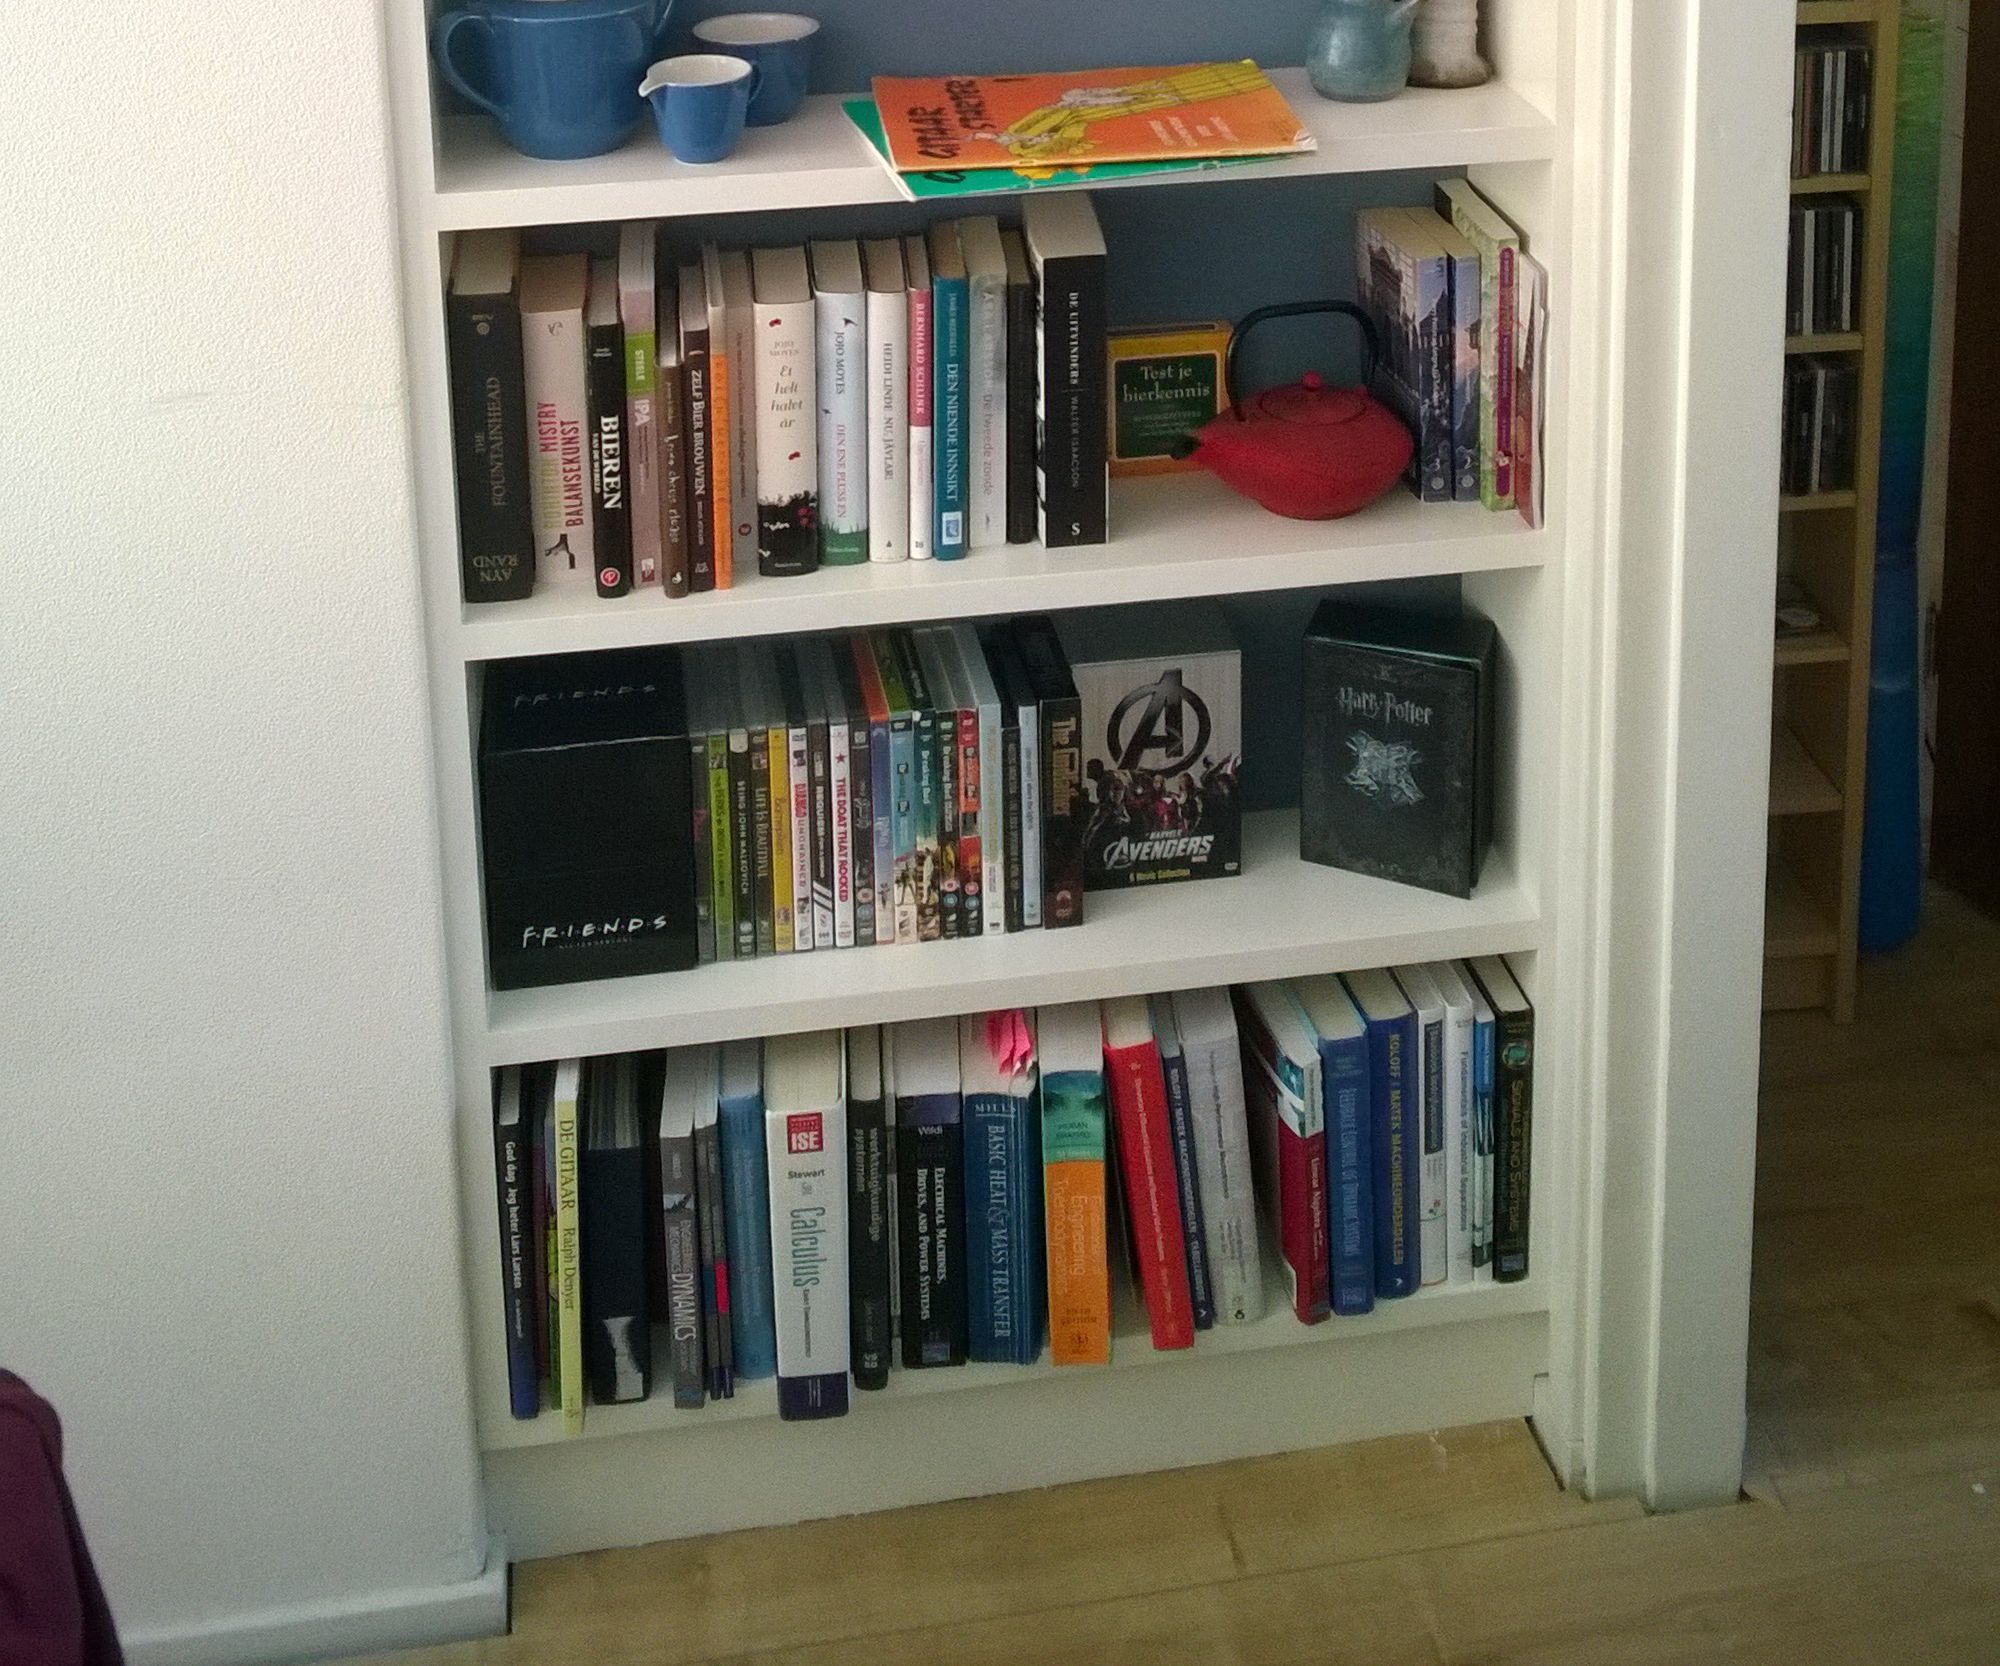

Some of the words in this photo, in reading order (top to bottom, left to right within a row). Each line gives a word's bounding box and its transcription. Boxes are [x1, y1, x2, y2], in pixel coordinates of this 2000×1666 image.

[1069, 292, 1079, 309] DE
[834, 331, 845, 356] JOJO
[915, 303, 925, 363] BERNHARD
[1069, 311, 1080, 385] UITVINDERS
[780, 365, 793, 377] Et
[836, 358, 845, 395] MOYES
[883, 343, 893, 375] HEIDI
[1140, 364, 1175, 381] Test
[1179, 362, 1193, 380] je
[691, 370, 703, 399] ZELF
[775, 381, 798, 394] helt
[883, 377, 893, 412] LINDE
[915, 366, 925, 414] SCHLINK
[945, 363, 958, 392] DEN
[1122, 380, 1210, 403] bierkennis
[634, 399, 650, 427] IPA
[771, 399, 803, 412] halvt
[983, 394, 993, 411] De
[1070, 396, 1079, 434] WALTER
[537, 402, 558, 452] MISTRY
[836, 424, 845, 447] DEN
[945, 395, 959, 447] NIENDE
[983, 413, 994, 458] tweede
[486, 376, 508, 507] FOUNTAINHEAD
[836, 448, 845, 469] ENE
[560, 419, 584, 527] BALANSEKUNST
[600, 415, 622, 510] BIEREN
[693, 432, 706, 495] BROUWEN
[946, 448, 959, 502] INNSIKT
[983, 458, 994, 496] zonde
[1070, 437, 1080, 489] ISAACSON
[837, 503, 846, 518] EN
[472, 554, 519, 568] RAND
[479, 567, 512, 584] AYN
[1337, 687, 1380, 719] Harry
[1384, 691, 1433, 726] Potter
[942, 746, 952, 782] Breaking
[737, 780, 746, 810] BEING
[754, 787, 767, 809] LIFE
[836, 777, 847, 798] THE
[944, 783, 953, 800] Bad
[738, 812, 747, 838] JOHN
[815, 785, 825, 836] REQUIEM
[837, 799, 847, 829] BOAT
[756, 823, 769, 878] BEAUTIFUL
[838, 830, 848, 859] THAT
[1103, 834, 1214, 870] AVENGERS
[739, 840, 749, 895] MALKOVICH
[838, 859, 848, 903] ROCKED
[1459, 1050, 1469, 1117] Fundamentals
[1460, 1119, 1469, 1129] of
[1508, 1079, 1522, 1138] SIGNALS
[559, 1119, 575, 1144] DE
[791, 1131, 820, 1151] ISE
[987, 1125, 1006, 1166] BASIC
[854, 1128, 867, 1192] systemen
[1509, 1140, 1521, 1167] AND
[504, 1164, 516, 1182] dag
[559, 1147, 575, 1212] GITAAR
[787, 1168, 826, 1180] Stewart
[867, 1128, 883, 1242] werktuigkundige
[988, 1169, 1007, 1206] HEAT
[1310, 1157, 1321, 1189] Linear
[506, 1187, 518, 1205] Jeg
[933, 1167, 945, 1226] ELECTRICAL
[1309, 1190, 1321, 1228] Algebra
[508, 1207, 520, 1232] heter
[917, 1211, 928, 1233] AND
[1069, 1195, 1088, 1276] Engineering
[509, 1234, 521, 1255] Lars
[562, 1227, 576, 1264] Ralph
[790, 1206, 828, 1288] Calculus
[918, 1235, 930, 1273] POWER
[990, 1228, 1009, 1264] MASS
[511, 1257, 523, 1288] Larsen
[562, 1266, 576, 1310] Denyer
[671, 1273, 697, 1341] DYNAMICS
[919, 1275, 931, 1321] SYSTEMS
[993, 1269, 1011, 1338] TRANSFER
